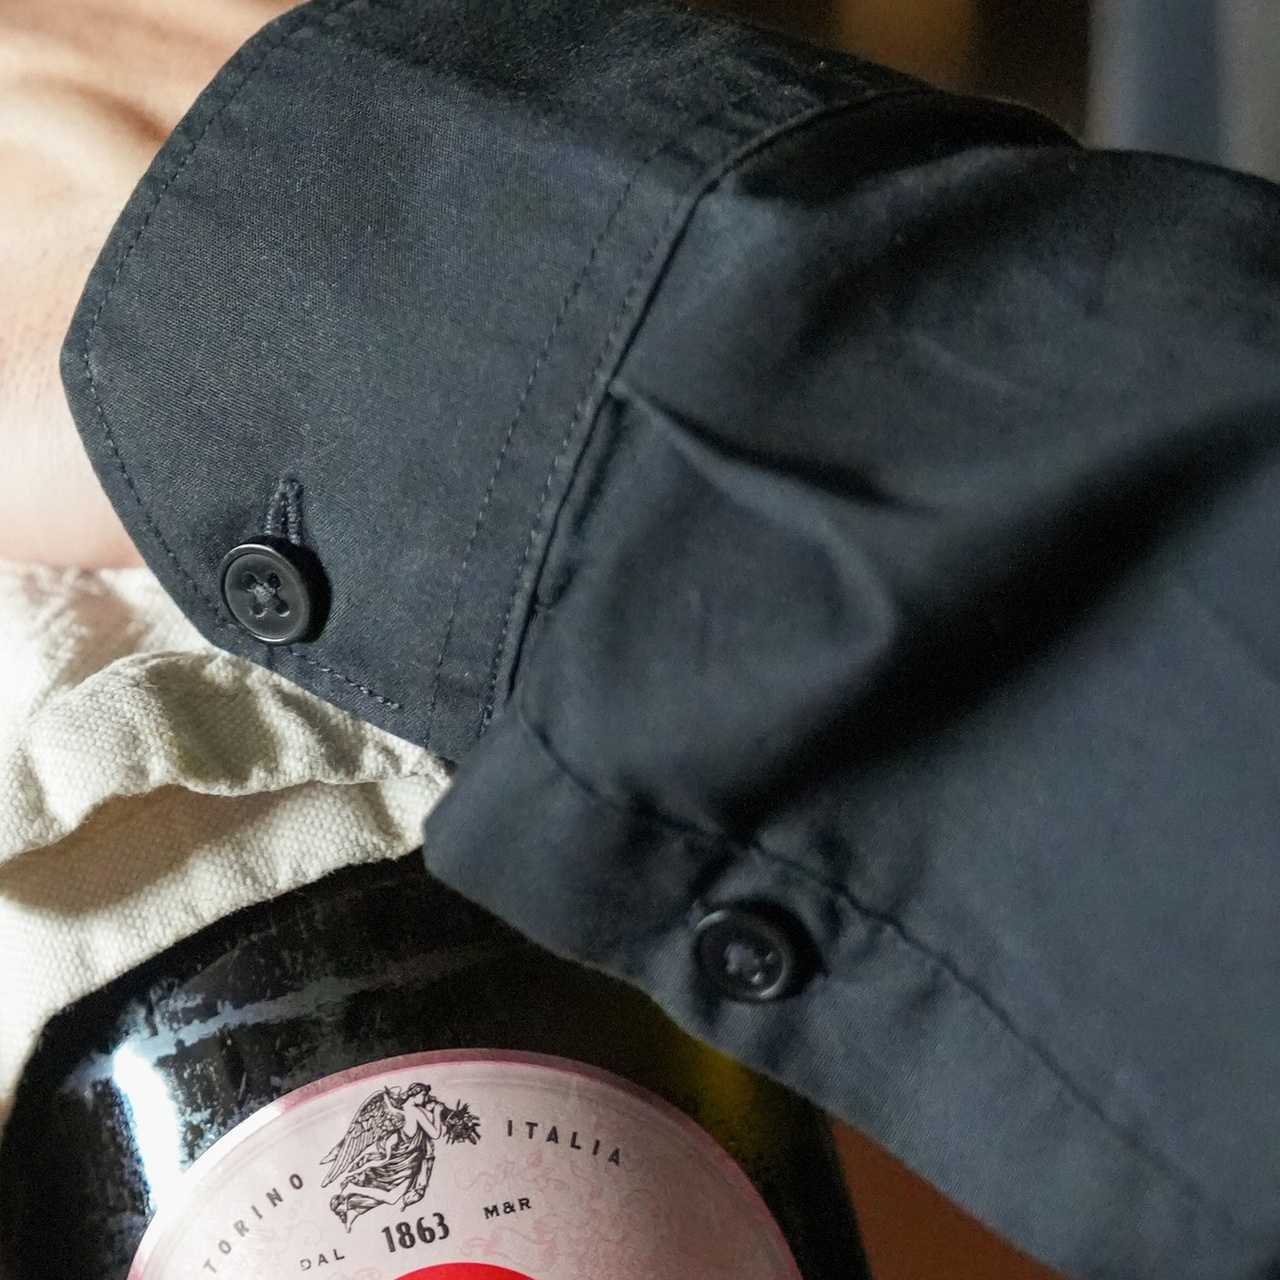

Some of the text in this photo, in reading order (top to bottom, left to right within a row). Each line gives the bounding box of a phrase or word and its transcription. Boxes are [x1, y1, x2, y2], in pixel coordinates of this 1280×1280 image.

[203, 1120, 620, 1275] TORINO ITALIA
[300, 1197, 531, 1271] DAL 1863 M&R
